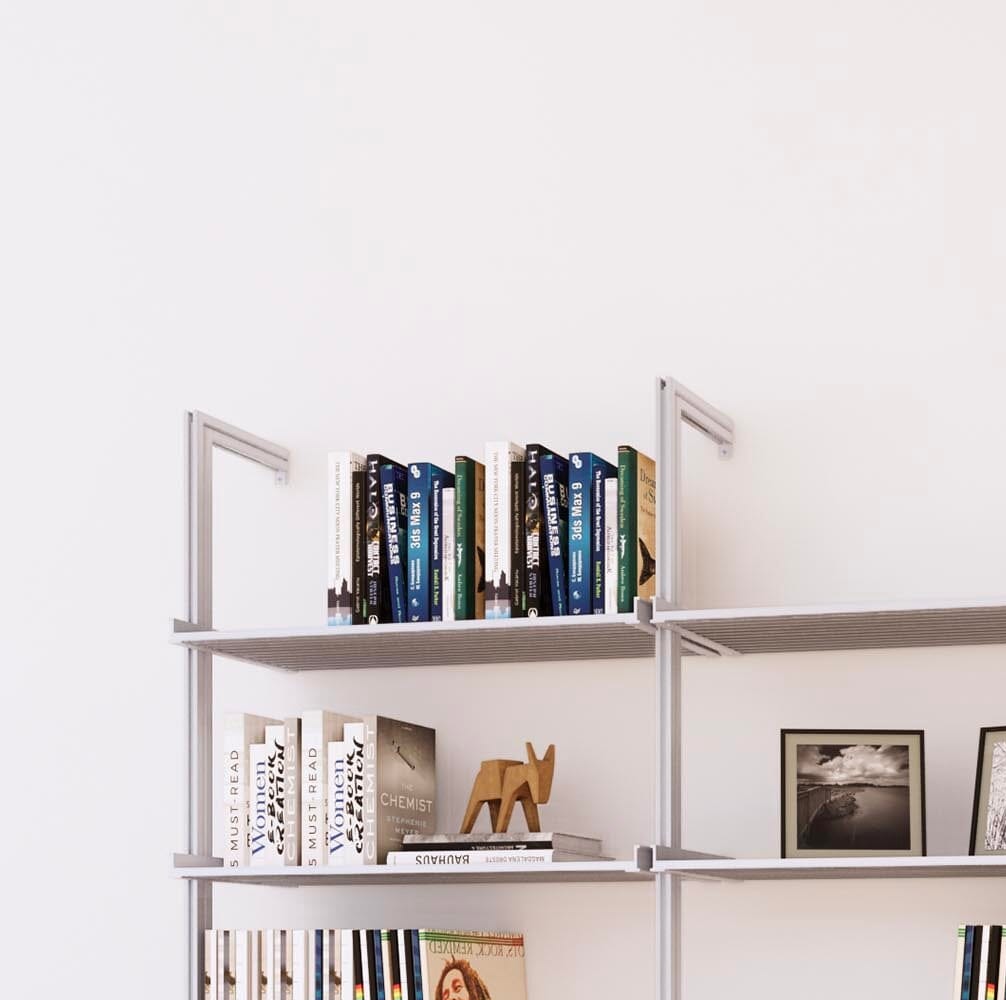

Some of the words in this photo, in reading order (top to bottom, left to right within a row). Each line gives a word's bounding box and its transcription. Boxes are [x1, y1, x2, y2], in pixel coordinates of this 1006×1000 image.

[368, 460, 379, 519] HALO
[410, 492, 420, 500] 9
[410, 502, 420, 526] Max
[528, 450, 538, 510] HALO
[547, 473, 561, 557] BUSINESS
[572, 482, 582, 490] 9
[572, 494, 582, 517] Max
[387, 483, 400, 565] BUSINESS
[410, 528, 420, 549] 3ds
[532, 531, 540, 566] CONTACT
[572, 520, 582, 541] 3ds
[230, 750, 239, 850] MUST-READ
[251, 761, 265, 856] Women
[267, 751, 276, 844] E-BOOK
[274, 737, 284, 855] CREATION
[287, 727, 296, 860] CHEMIST
[308, 747, 317, 849] MUST-READ
[329, 759, 344, 855] Women
[346, 749, 355, 842] E-BOOK
[352, 736, 364, 854] CREATION
[366, 724, 375, 860] CHEMIST
[381, 792, 432, 813] CHEMIST
[401, 783, 414, 792] THE
[415, 855, 470, 865] BAUHAUS
